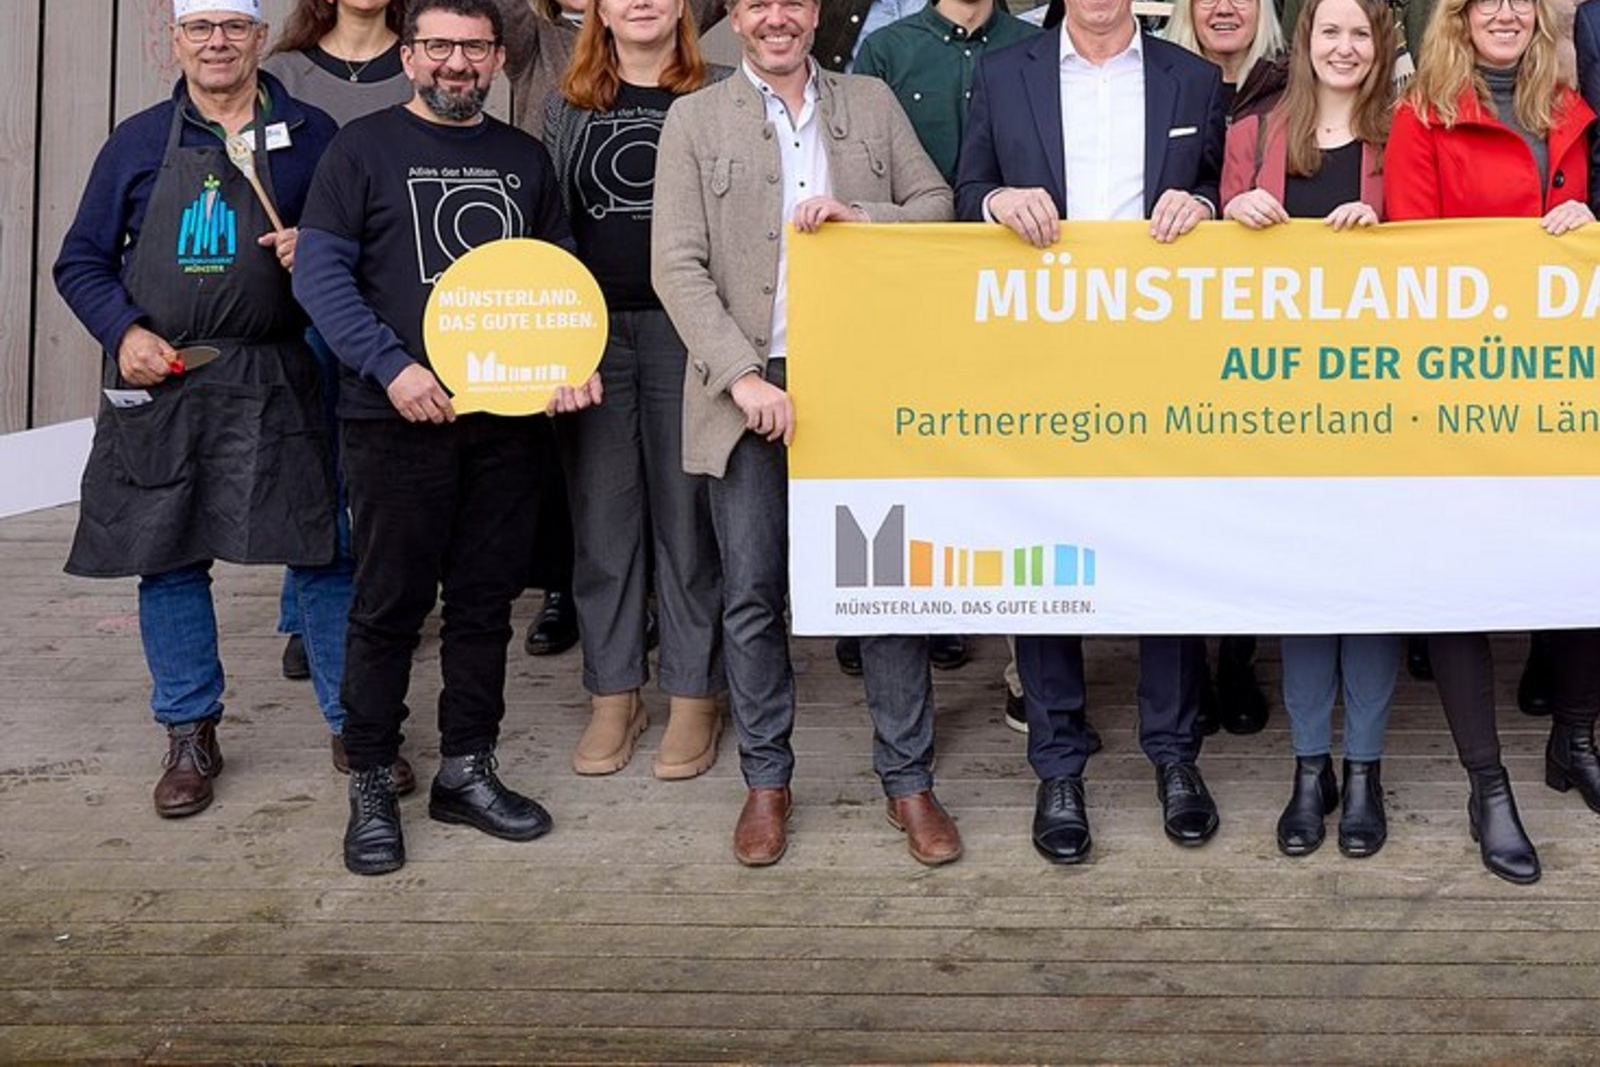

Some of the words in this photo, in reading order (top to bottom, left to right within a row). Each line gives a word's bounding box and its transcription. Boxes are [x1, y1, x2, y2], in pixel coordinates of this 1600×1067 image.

[439, 287, 581, 307] MÜNSTERLAND.
[975, 252, 1508, 322] MÜNSTERLAND.
[439, 313, 476, 332] DAS
[482, 312, 529, 330] GUTE
[535, 311, 597, 329] LEBEN.
[1221, 347, 1301, 381] AUF
[1318, 347, 1401, 380] DER
[1417, 336, 1595, 379] GRÜNEN
[896, 403, 1147, 443] Partnerregion
[1165, 403, 1393, 434] Münsterland
[1438, 405, 1519, 433] NRW
[835, 599, 957, 615] MÜNSTERLAND.
[962, 601, 992, 615] DAS
[997, 600, 1037, 615] GUTE
[1042, 600, 1096, 614] LEBEN.
